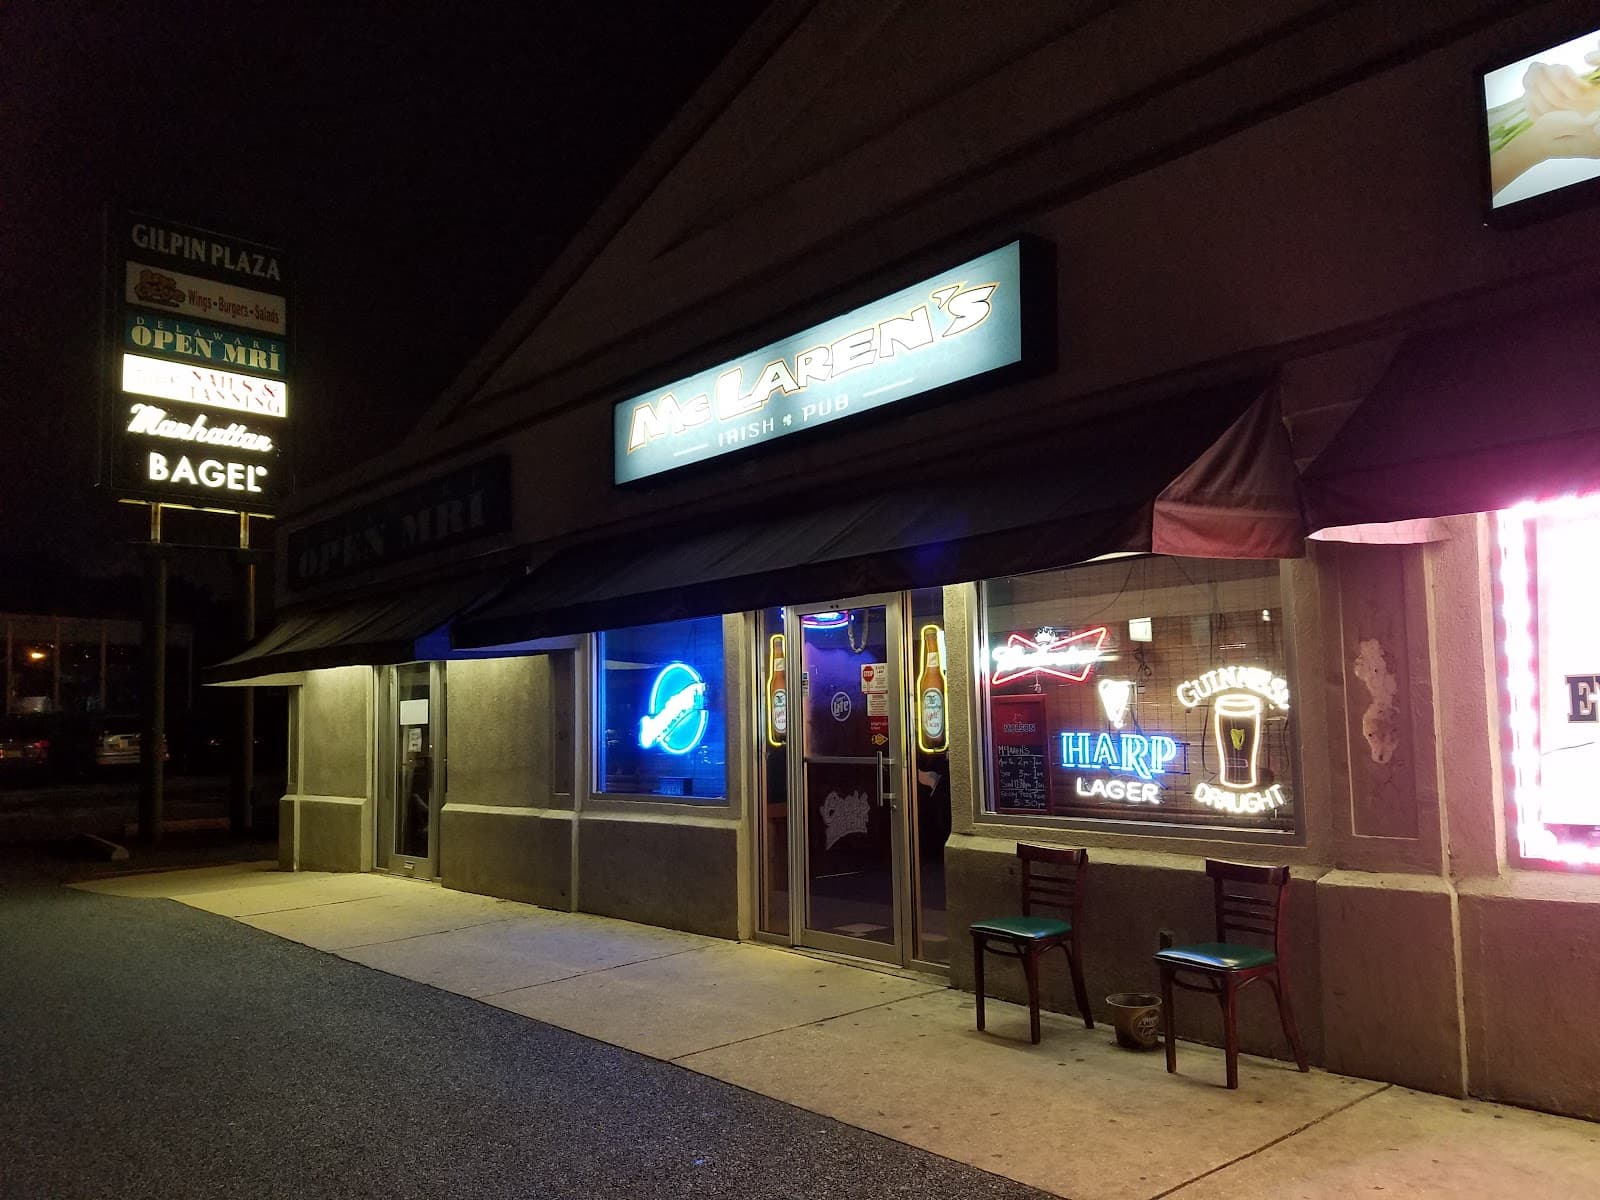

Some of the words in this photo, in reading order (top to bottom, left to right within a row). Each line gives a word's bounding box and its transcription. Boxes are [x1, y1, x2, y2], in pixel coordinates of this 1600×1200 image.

[131, 223, 206, 264] GILPIN
[211, 243, 281, 281] PLAZA
[187, 288, 213, 313] Wings
[218, 295, 250, 318] Burgers
[254, 303, 280, 325] Salads
[131, 325, 213, 362] OPEN
[223, 344, 281, 372] MRI
[136, 316, 278, 353] DELAWARE
[127, 403, 275, 452] Manhattan
[717, 416, 775, 449] IRISH
[802, 392, 850, 423] PUB
[149, 451, 264, 493] BAGEL
[1565, 674, 1600, 723] E
[1060, 731, 1176, 780] HARP
[1075, 777, 1160, 804] LAGER
[1193, 782, 1284, 814] DRAUGHT
